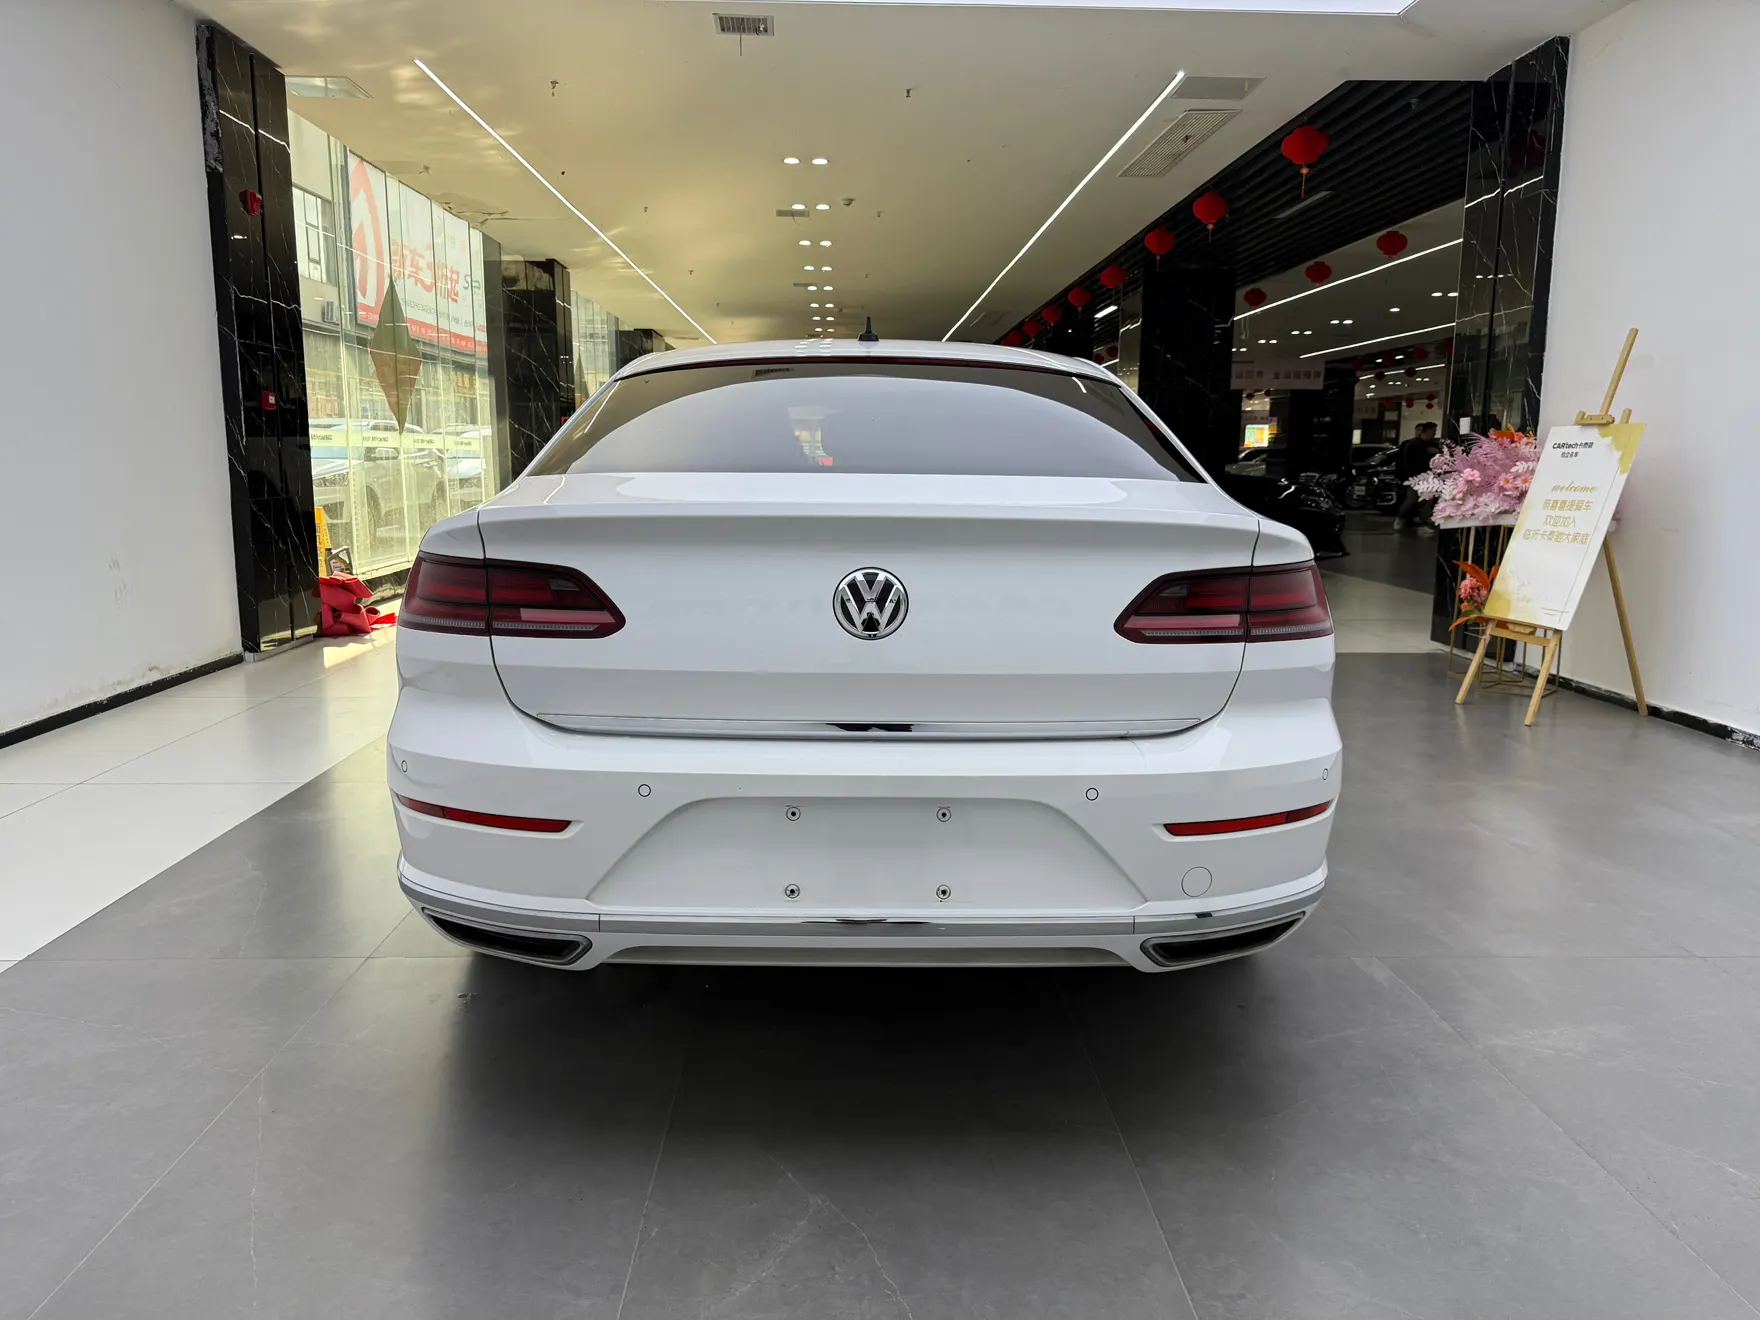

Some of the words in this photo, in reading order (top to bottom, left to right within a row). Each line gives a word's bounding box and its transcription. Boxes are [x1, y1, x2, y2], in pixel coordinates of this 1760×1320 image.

[1552, 442, 1578, 450] CARtech
[1551, 481, 1597, 493] welcome
[1544, 515, 1576, 528] 欢迎加入
